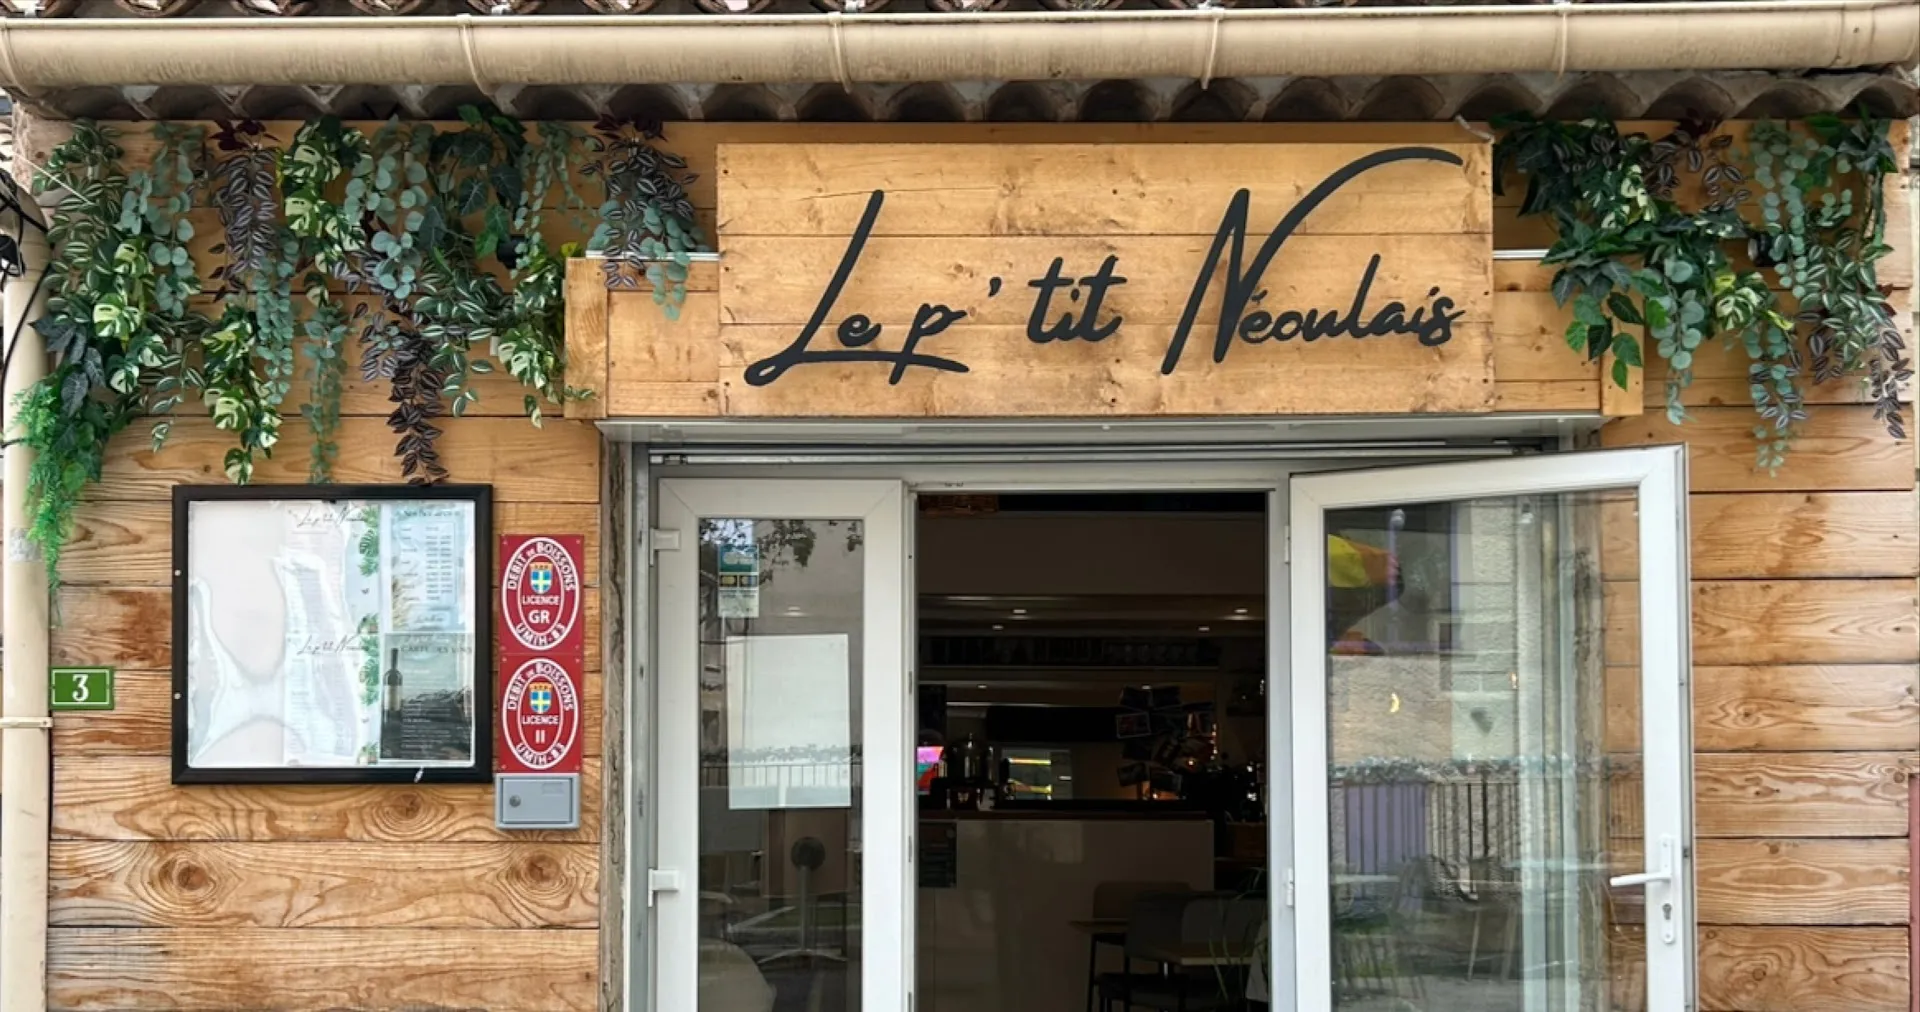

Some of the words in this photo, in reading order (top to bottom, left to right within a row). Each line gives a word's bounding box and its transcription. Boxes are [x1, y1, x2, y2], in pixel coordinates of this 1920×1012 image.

[745, 190, 885, 385] Le
[1162, 146, 1466, 376] Néoulais
[507, 553, 528, 590] DEBIT
[536, 541, 576, 591] BOISSONS
[522, 594, 560, 606] LICENCE
[528, 609, 550, 624] GR
[72, 673, 89, 702] 3
[507, 674, 527, 711] DEBIT
[535, 661, 574, 711] BOISSONS
[522, 715, 560, 725] LICENCE
[535, 729, 546, 744] II
